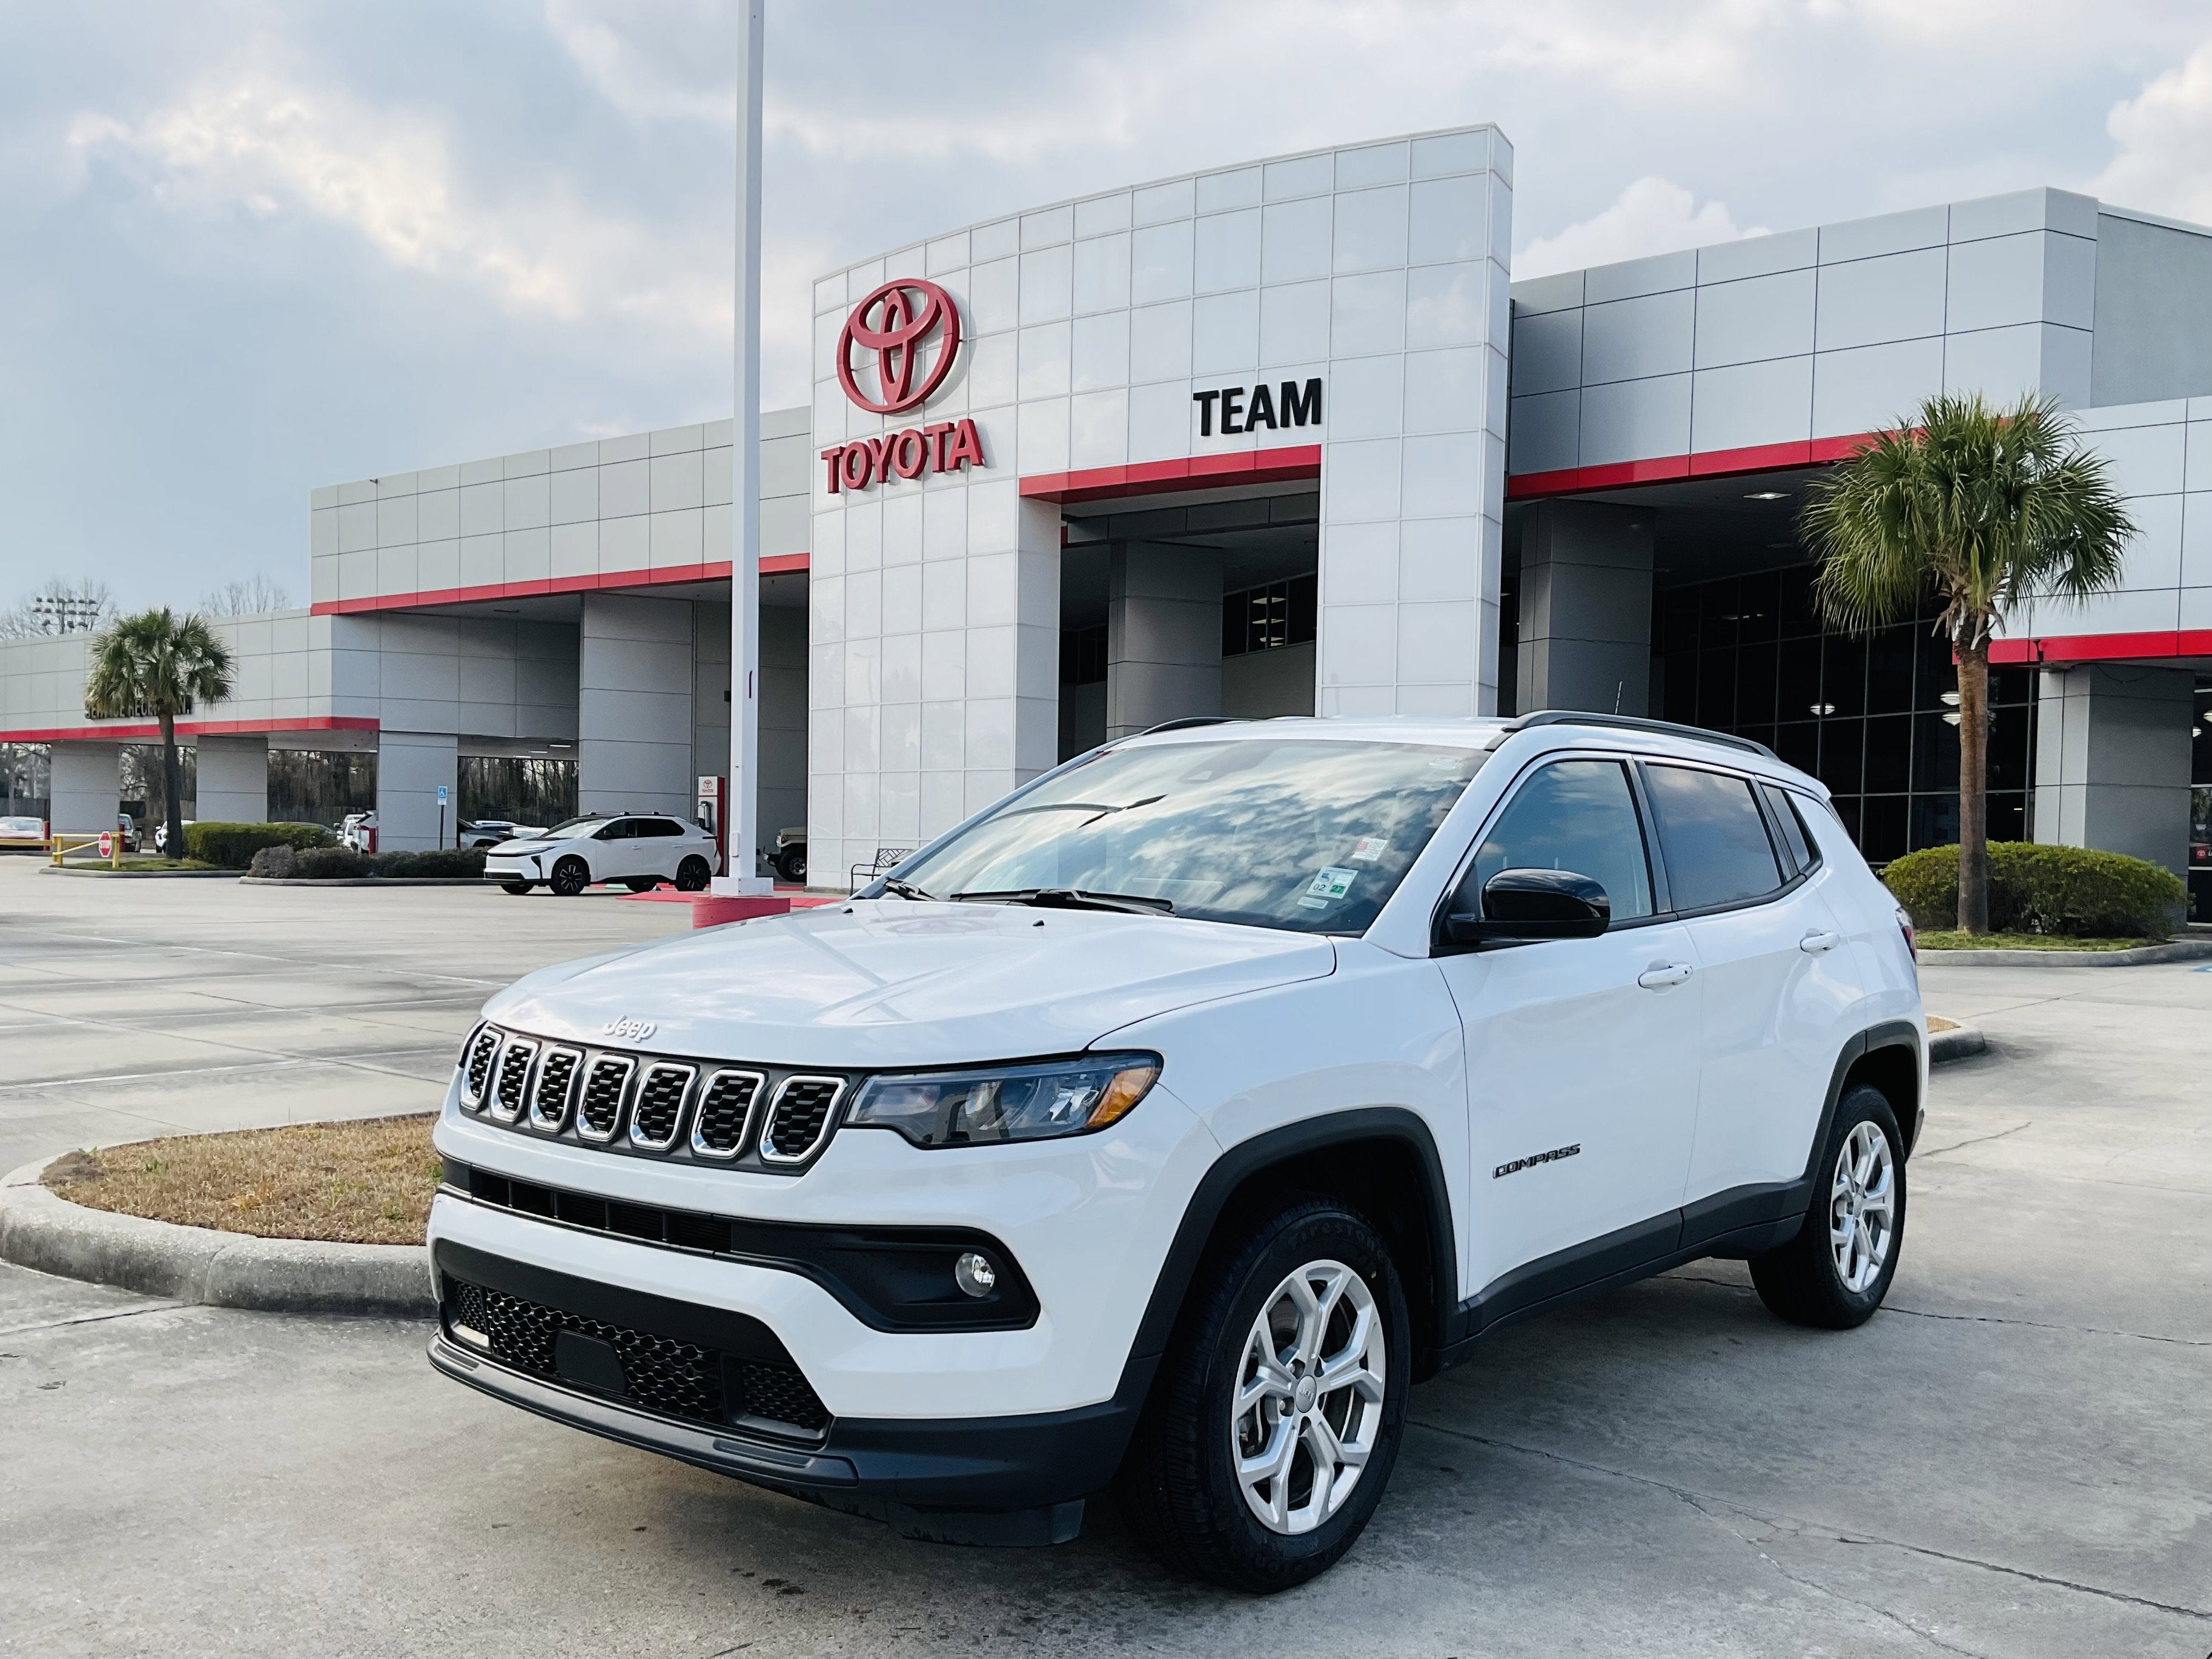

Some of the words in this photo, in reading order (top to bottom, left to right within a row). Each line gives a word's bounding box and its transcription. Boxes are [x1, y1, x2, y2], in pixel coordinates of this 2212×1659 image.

[1193, 378, 1321, 436] TEAM
[821, 419, 984, 494] TOYOTA
[84, 698, 125, 720] SECE
[100, 839, 111, 849] STOP
[1330, 885, 1345, 893] 27
[602, 1015, 657, 1043] Jeep
[1492, 1144, 1580, 1179] COMPASS
